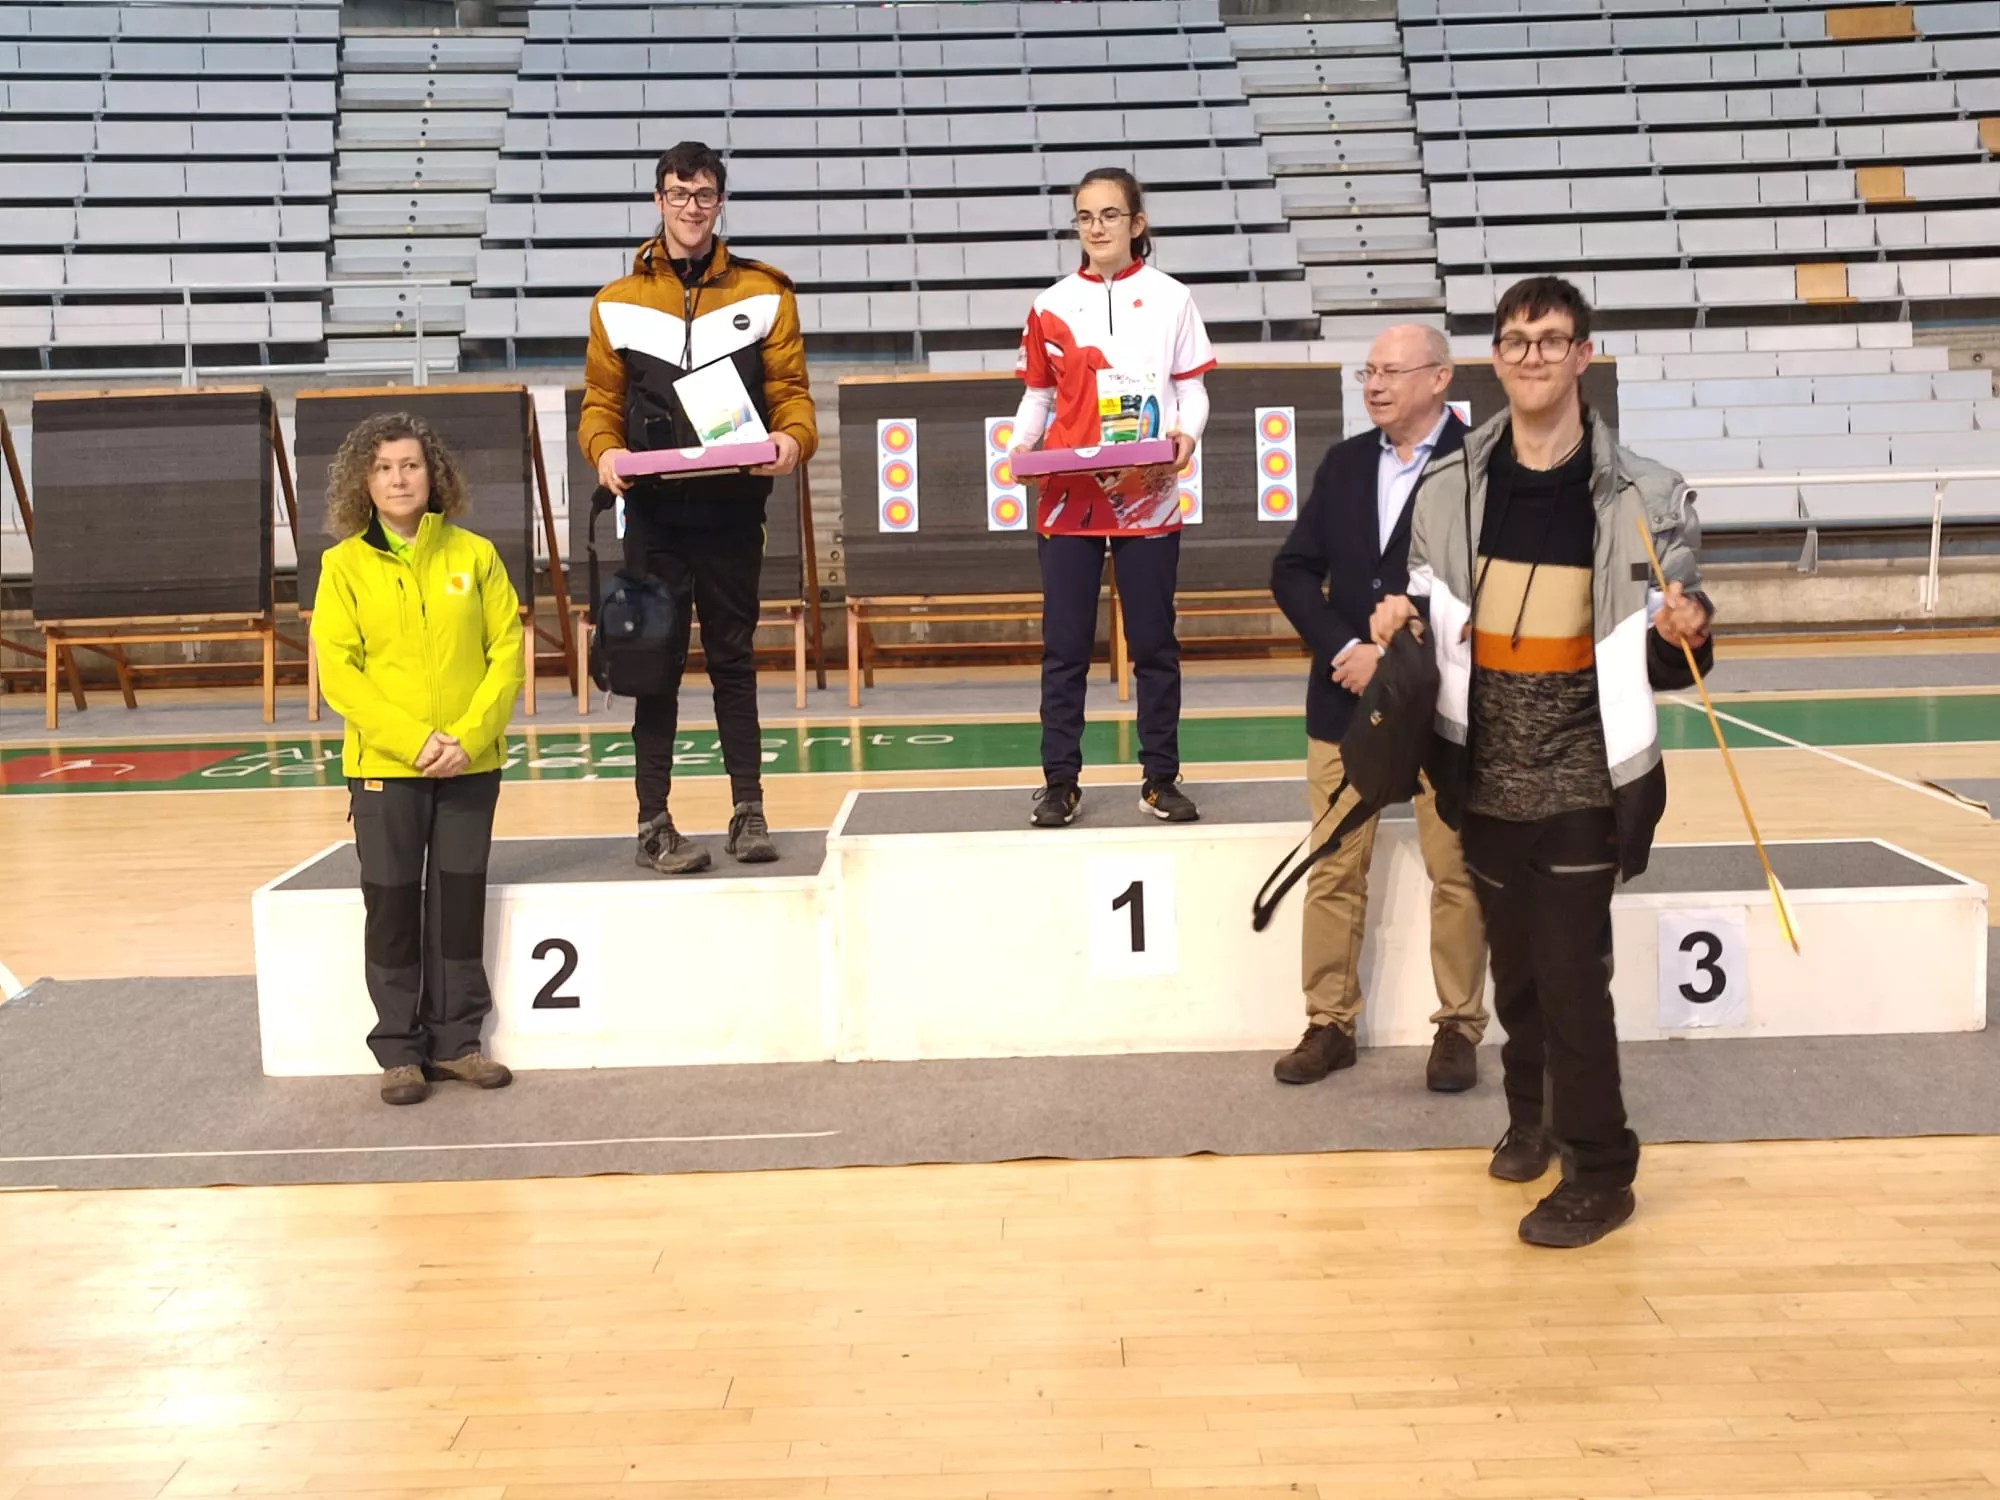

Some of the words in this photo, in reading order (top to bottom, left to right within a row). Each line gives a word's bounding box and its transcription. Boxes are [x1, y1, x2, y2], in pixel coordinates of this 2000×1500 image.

[201, 761, 325, 777] de
[1112, 880, 1145, 952] 1
[531, 938, 580, 1009] 2
[1678, 930, 1726, 1004] 3
